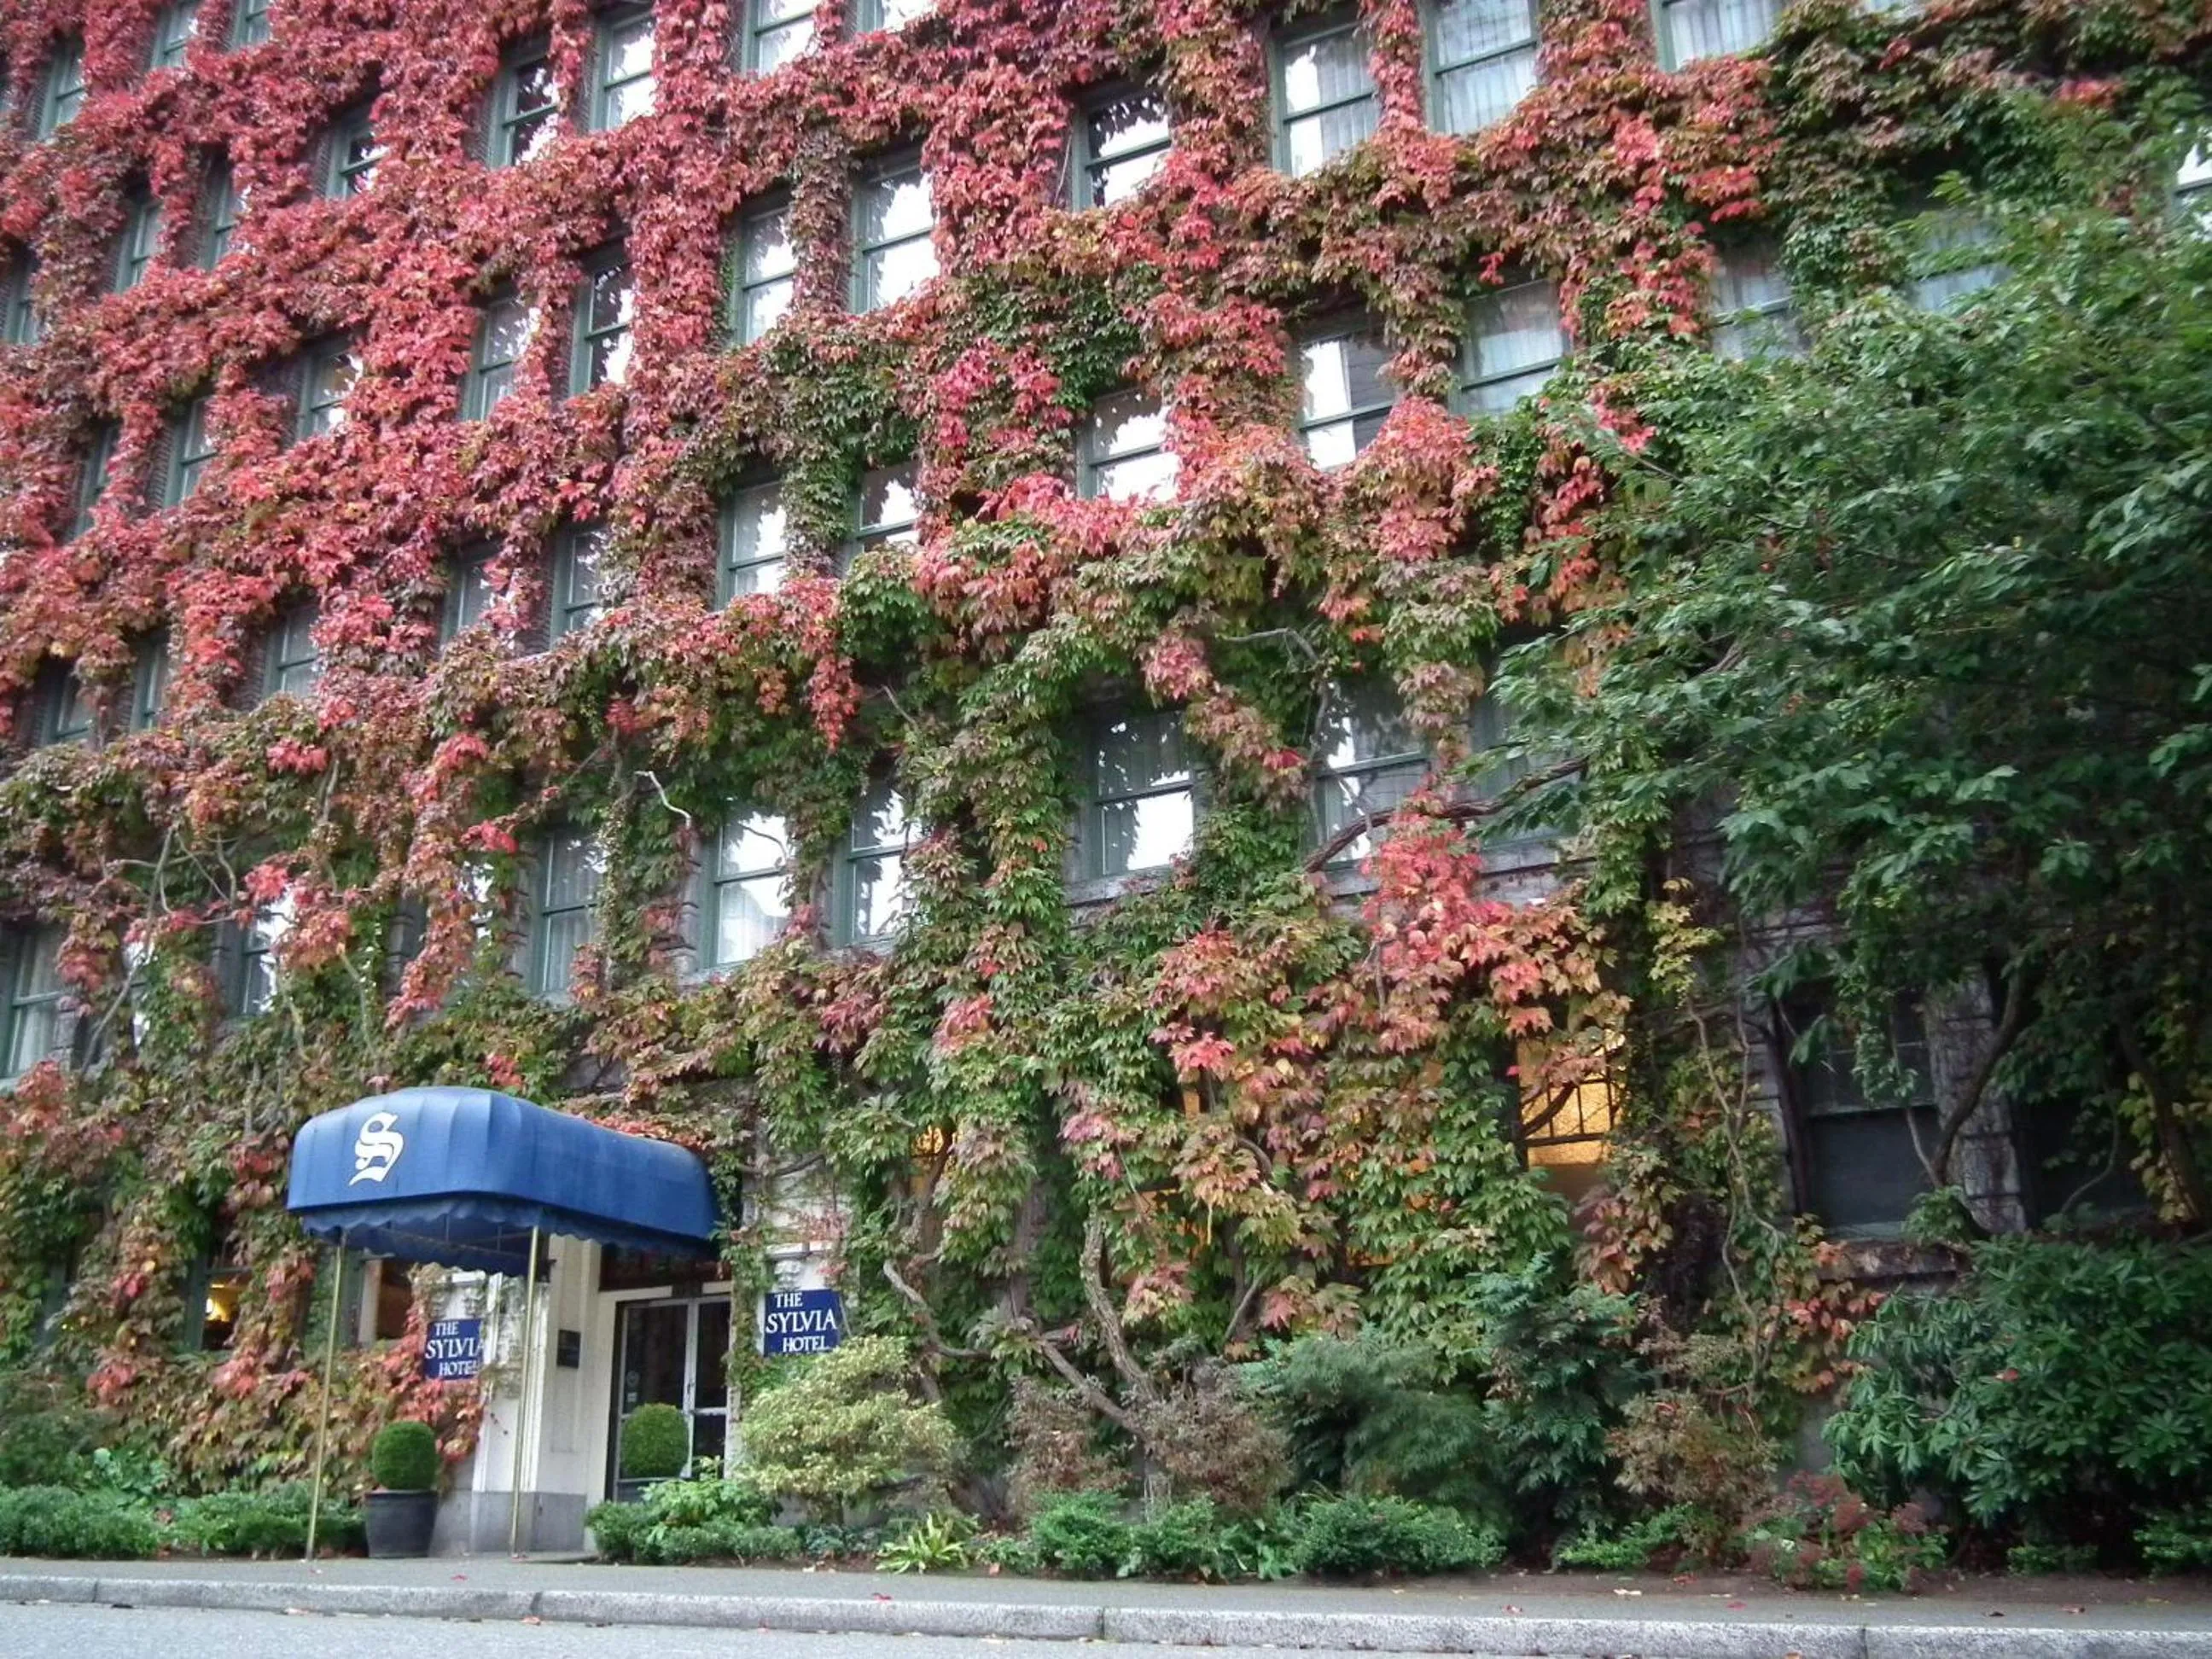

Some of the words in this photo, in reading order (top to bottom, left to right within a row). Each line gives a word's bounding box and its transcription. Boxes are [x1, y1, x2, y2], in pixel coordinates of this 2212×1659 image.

[774, 1292, 803, 1308] THE
[434, 1321, 459, 1336] THE
[765, 1308, 837, 1334] SYLVIA
[783, 1336, 830, 1353] HOTEL
